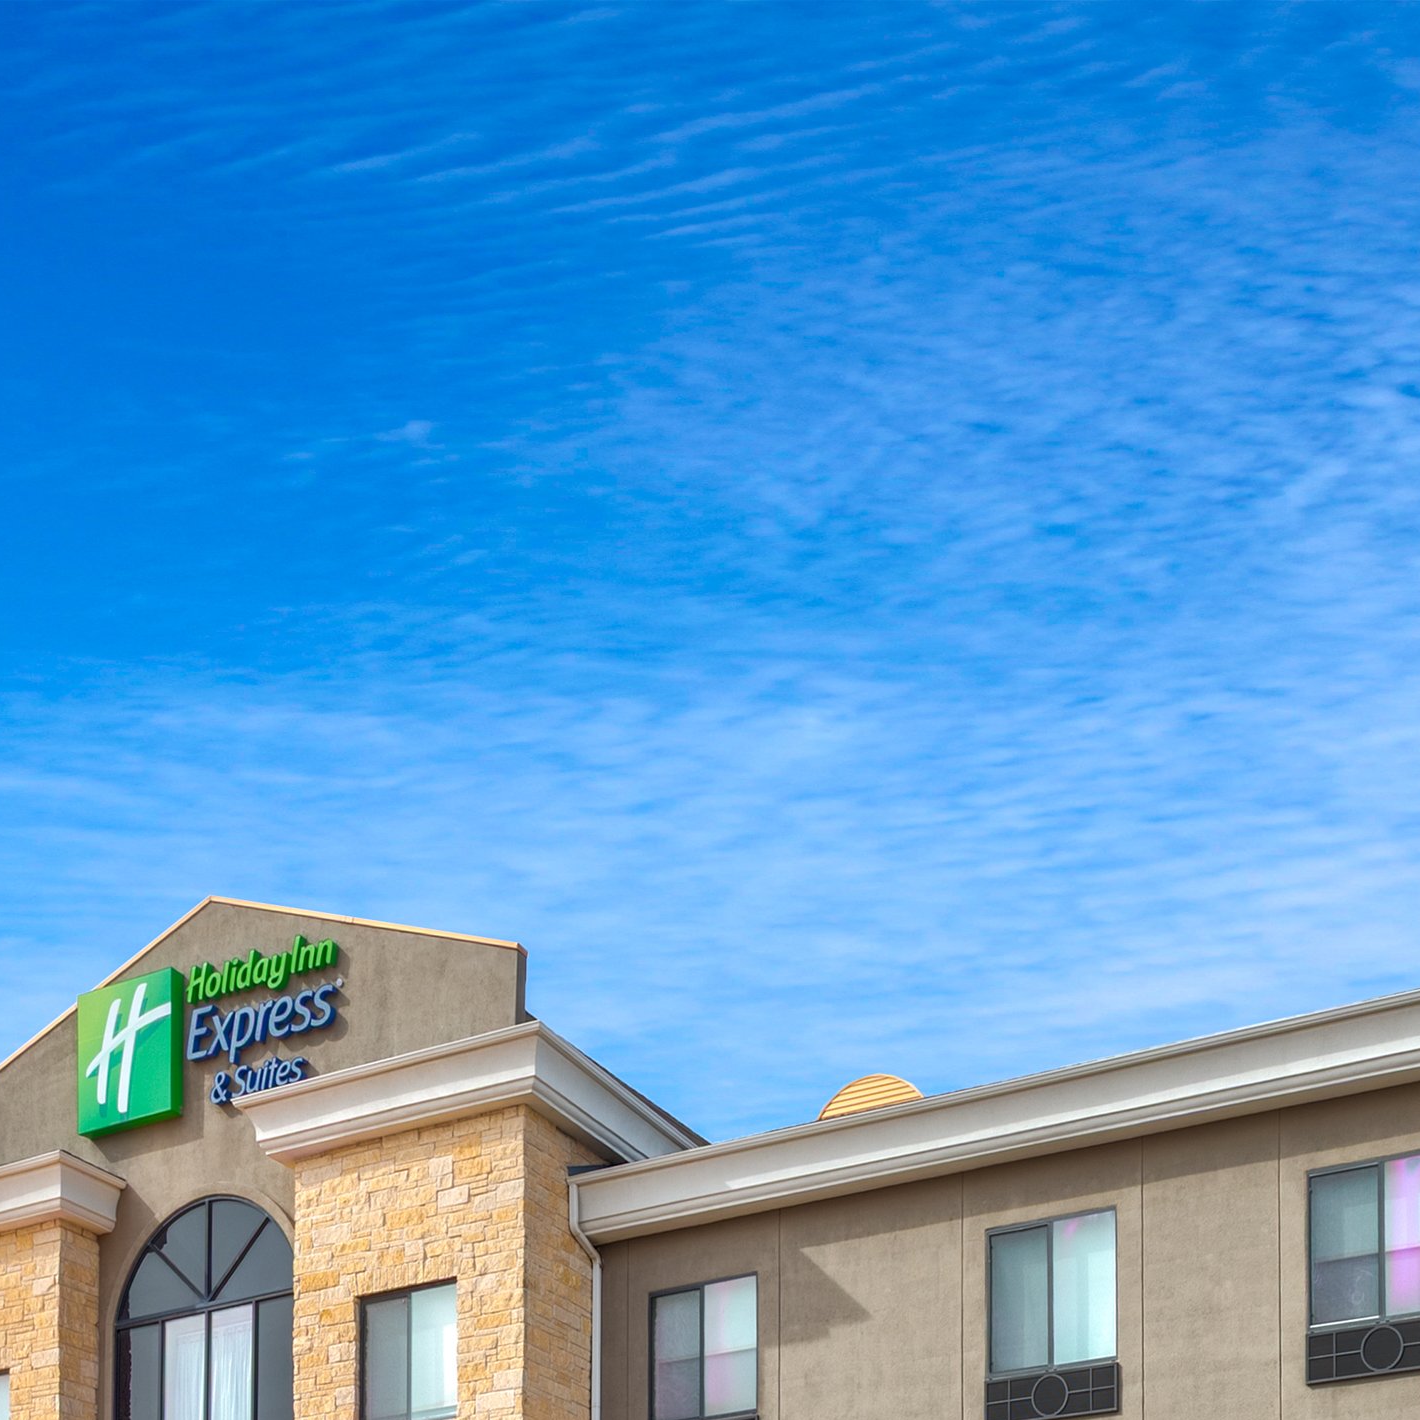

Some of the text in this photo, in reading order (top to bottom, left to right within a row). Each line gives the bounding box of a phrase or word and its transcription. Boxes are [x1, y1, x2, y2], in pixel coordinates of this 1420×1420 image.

[185, 934, 340, 1003] Holiday Inn
[185, 983, 338, 1063] Express
[210, 1056, 307, 1104] & Suites
